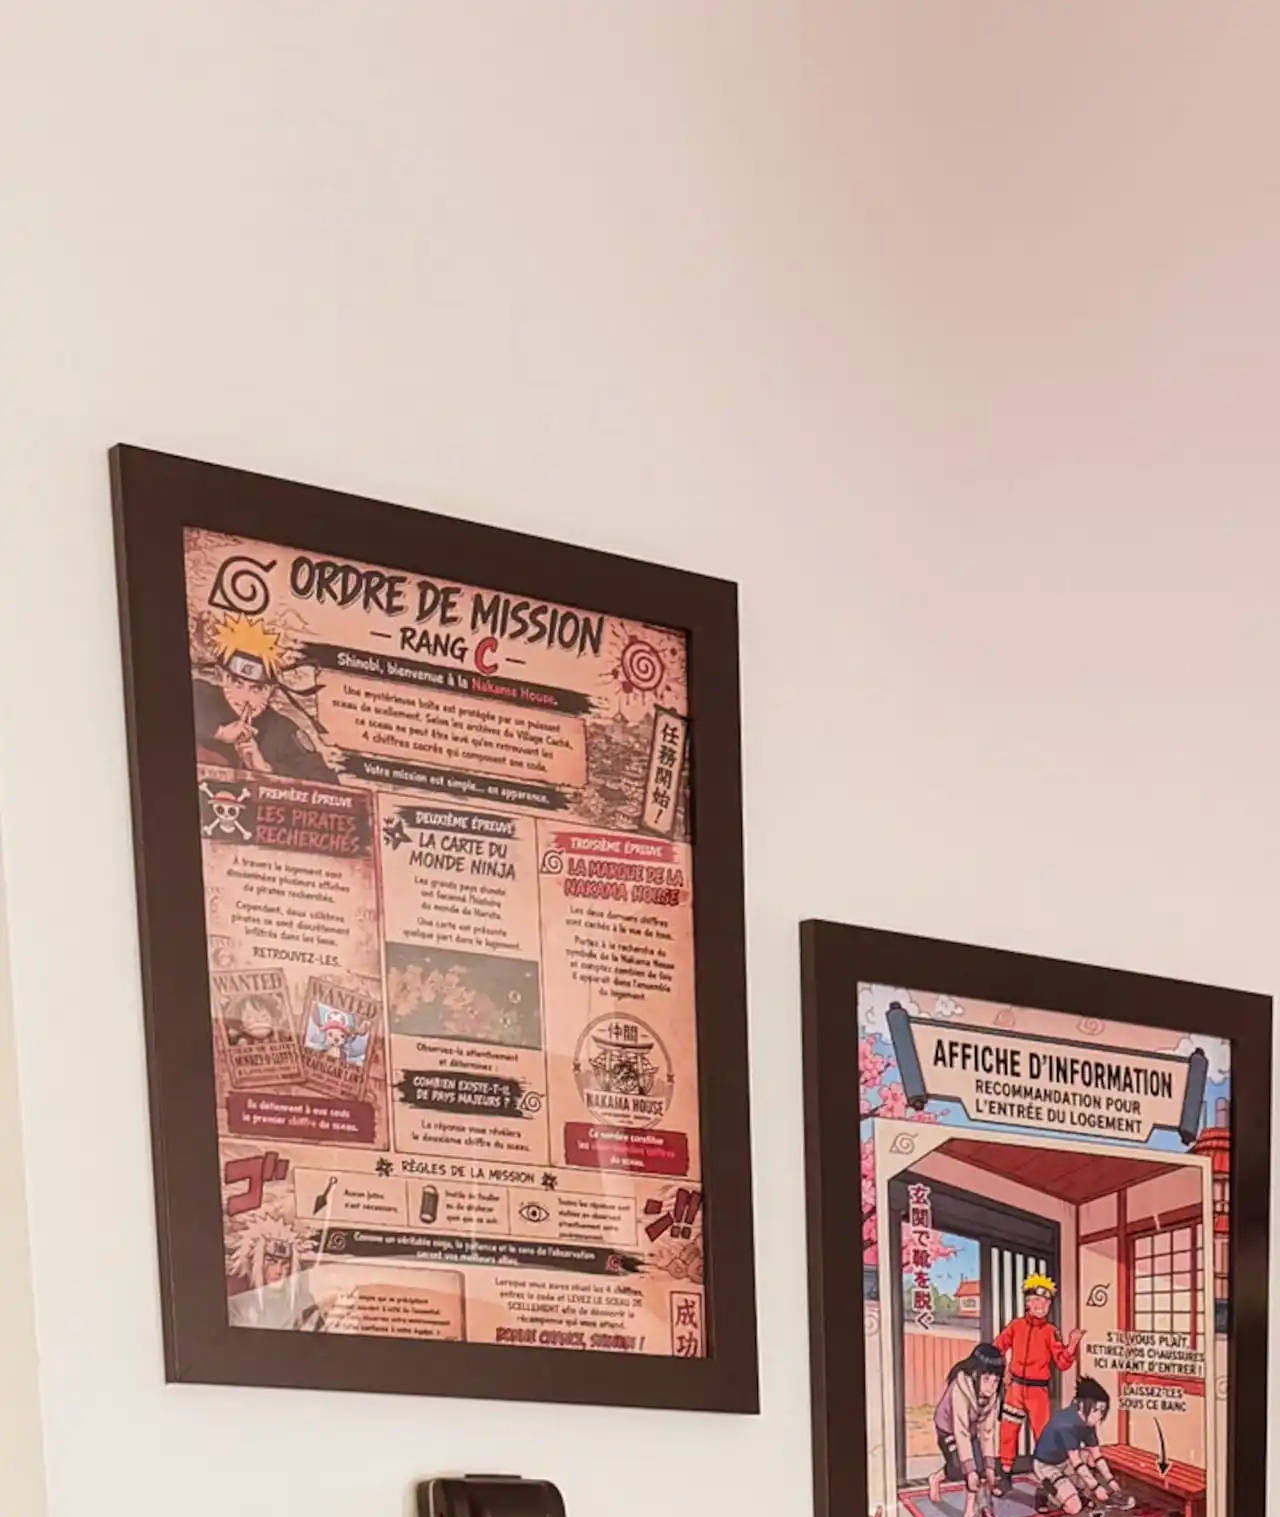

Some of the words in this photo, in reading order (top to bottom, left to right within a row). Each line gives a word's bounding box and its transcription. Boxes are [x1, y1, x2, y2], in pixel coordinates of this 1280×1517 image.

[290, 556, 408, 616] ORDRE
[413, 578, 459, 630] DE
[470, 589, 605, 661] MISSION
[399, 624, 468, 662] RANG
[473, 633, 499, 675] C
[336, 651, 383, 675] Shinobi,
[386, 660, 443, 684] bienvenue
[447, 672, 454, 686] à
[458, 674, 468, 689] la
[472, 677, 516, 698] Nakama
[520, 686, 557, 705] House.
[258, 787, 309, 802] PREMIÈRE
[312, 791, 353, 808] ÉPREUVE
[364, 762, 390, 777] Votre
[392, 767, 427, 784] mission
[430, 774, 443, 786] est
[487, 785, 498, 795] en
[501, 788, 550, 806] apparence.
[256, 806, 285, 823] LES
[292, 808, 357, 834] PIRATES
[415, 811, 468, 829] DEUXIÈME
[471, 816, 515, 835] ÉPREUVE
[419, 831, 435, 849] LA
[440, 836, 484, 857] CARTE
[488, 841, 507, 859] DU
[571, 835, 621, 852] TROISIÈME
[624, 841, 662, 858] ÉPREUVE
[409, 850, 465, 872] MONDE
[470, 859, 515, 880] NINJA
[568, 857, 587, 878] LA
[588, 859, 643, 886] MARQUE
[646, 866, 665, 884] DE
[666, 868, 684, 888] LA
[565, 877, 627, 900] NAKAMA
[631, 884, 680, 906] HOUSE
[253, 946, 342, 967] RETROUVEZ-LES.
[212, 972, 283, 993] WANTED
[311, 981, 378, 1020] WANTED
[933, 1038, 1021, 1078] AFFICHE
[1029, 1052, 1173, 1099] D'INFORMATION
[413, 1075, 455, 1090] COMBIEN
[457, 1080, 510, 1096] EXISTE-T-IL
[416, 1089, 427, 1100] DE
[431, 1090, 456, 1103] PAYS
[457, 1092, 500, 1107] MAJEURS
[504, 1097, 510, 1108] ?
[975, 1079, 1101, 1109] RECOMMANDATION
[1105, 1098, 1142, 1115] POUR
[586, 1092, 630, 1111] NAKAMA
[632, 1096, 664, 1117] HOUSE
[975, 1098, 1043, 1121] L'ENTRÉE
[1047, 1108, 1066, 1124] DU
[1070, 1110, 1143, 1134] LOGEMENT
[401, 1157, 446, 1175] RÈGLES
[451, 1165, 465, 1176] DE
[470, 1167, 484, 1178] LA
[488, 1168, 534, 1184] MISSION
[1086, 1344, 1124, 1356] RETIREZ
[1126, 1347, 1145, 1358] VOS
[1147, 1348, 1205, 1362] CHAUSSURES
[1128, 1334, 1156, 1346] VOUS
[1094, 1358, 1108, 1369] ICI
[1111, 1359, 1145, 1371] AVANT
[1148, 1361, 1196, 1374] D'ENTRER
[1119, 1398, 1144, 1410] SOUS
[1146, 1399, 1158, 1411] CE
[1123, 1383, 1183, 1399] LAISSEZ-LES
